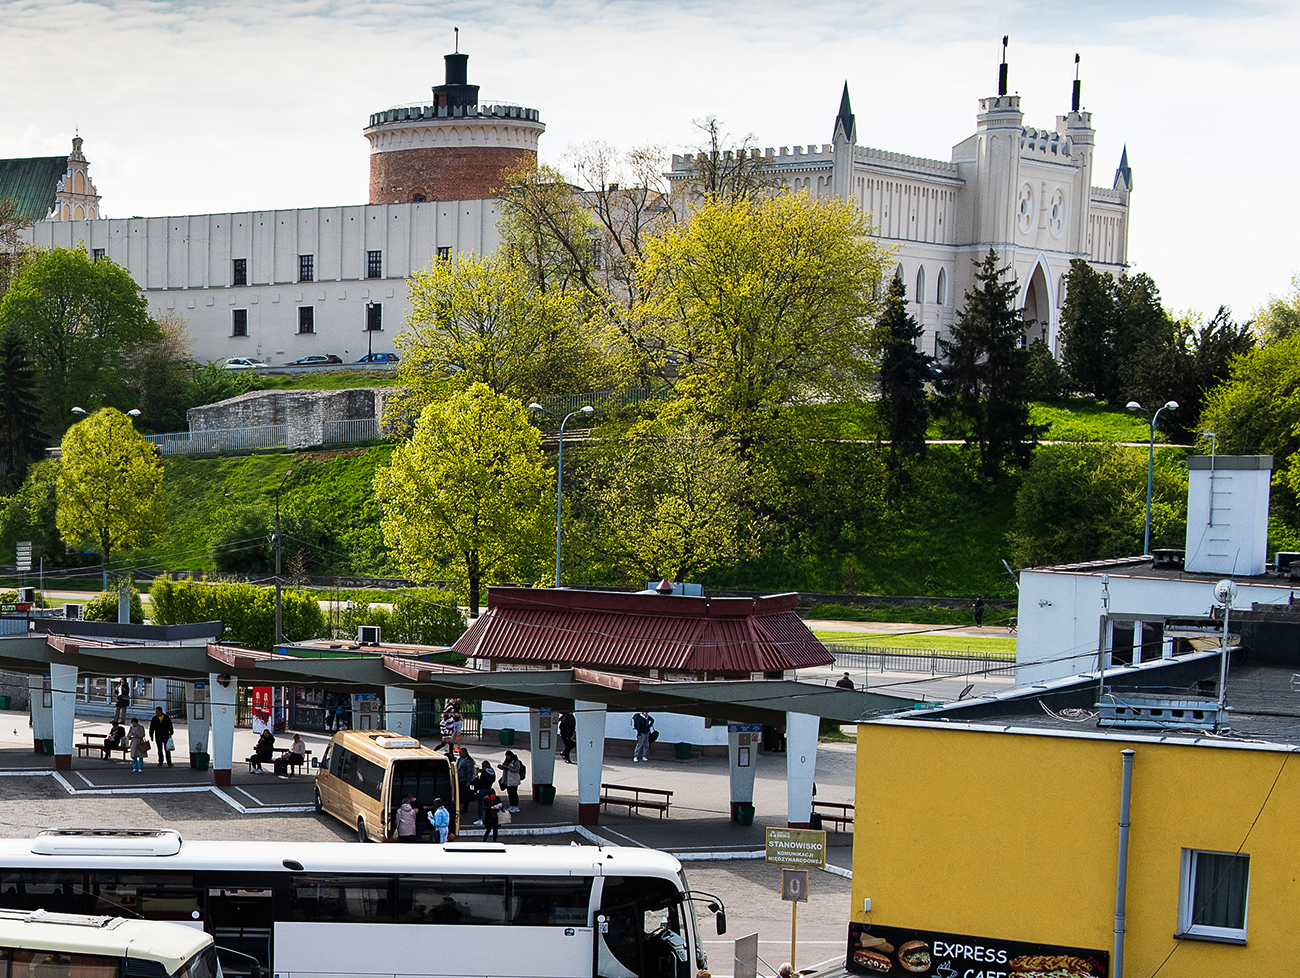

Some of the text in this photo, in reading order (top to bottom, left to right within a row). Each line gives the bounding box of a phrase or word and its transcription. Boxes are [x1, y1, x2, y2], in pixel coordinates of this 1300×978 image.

[222, 707, 227, 715] 3
[396, 720, 403, 729] 2
[588, 740, 594, 748] 1
[800, 755, 806, 764] 0
[768, 841, 823, 850] STANOWISKO
[768, 856, 822, 864] MIĘDZYNARODOWEJ
[789, 878, 800, 894] 0
[933, 941, 1008, 964] EXPRESS
[1086, 955, 1106, 975] 7/24h
